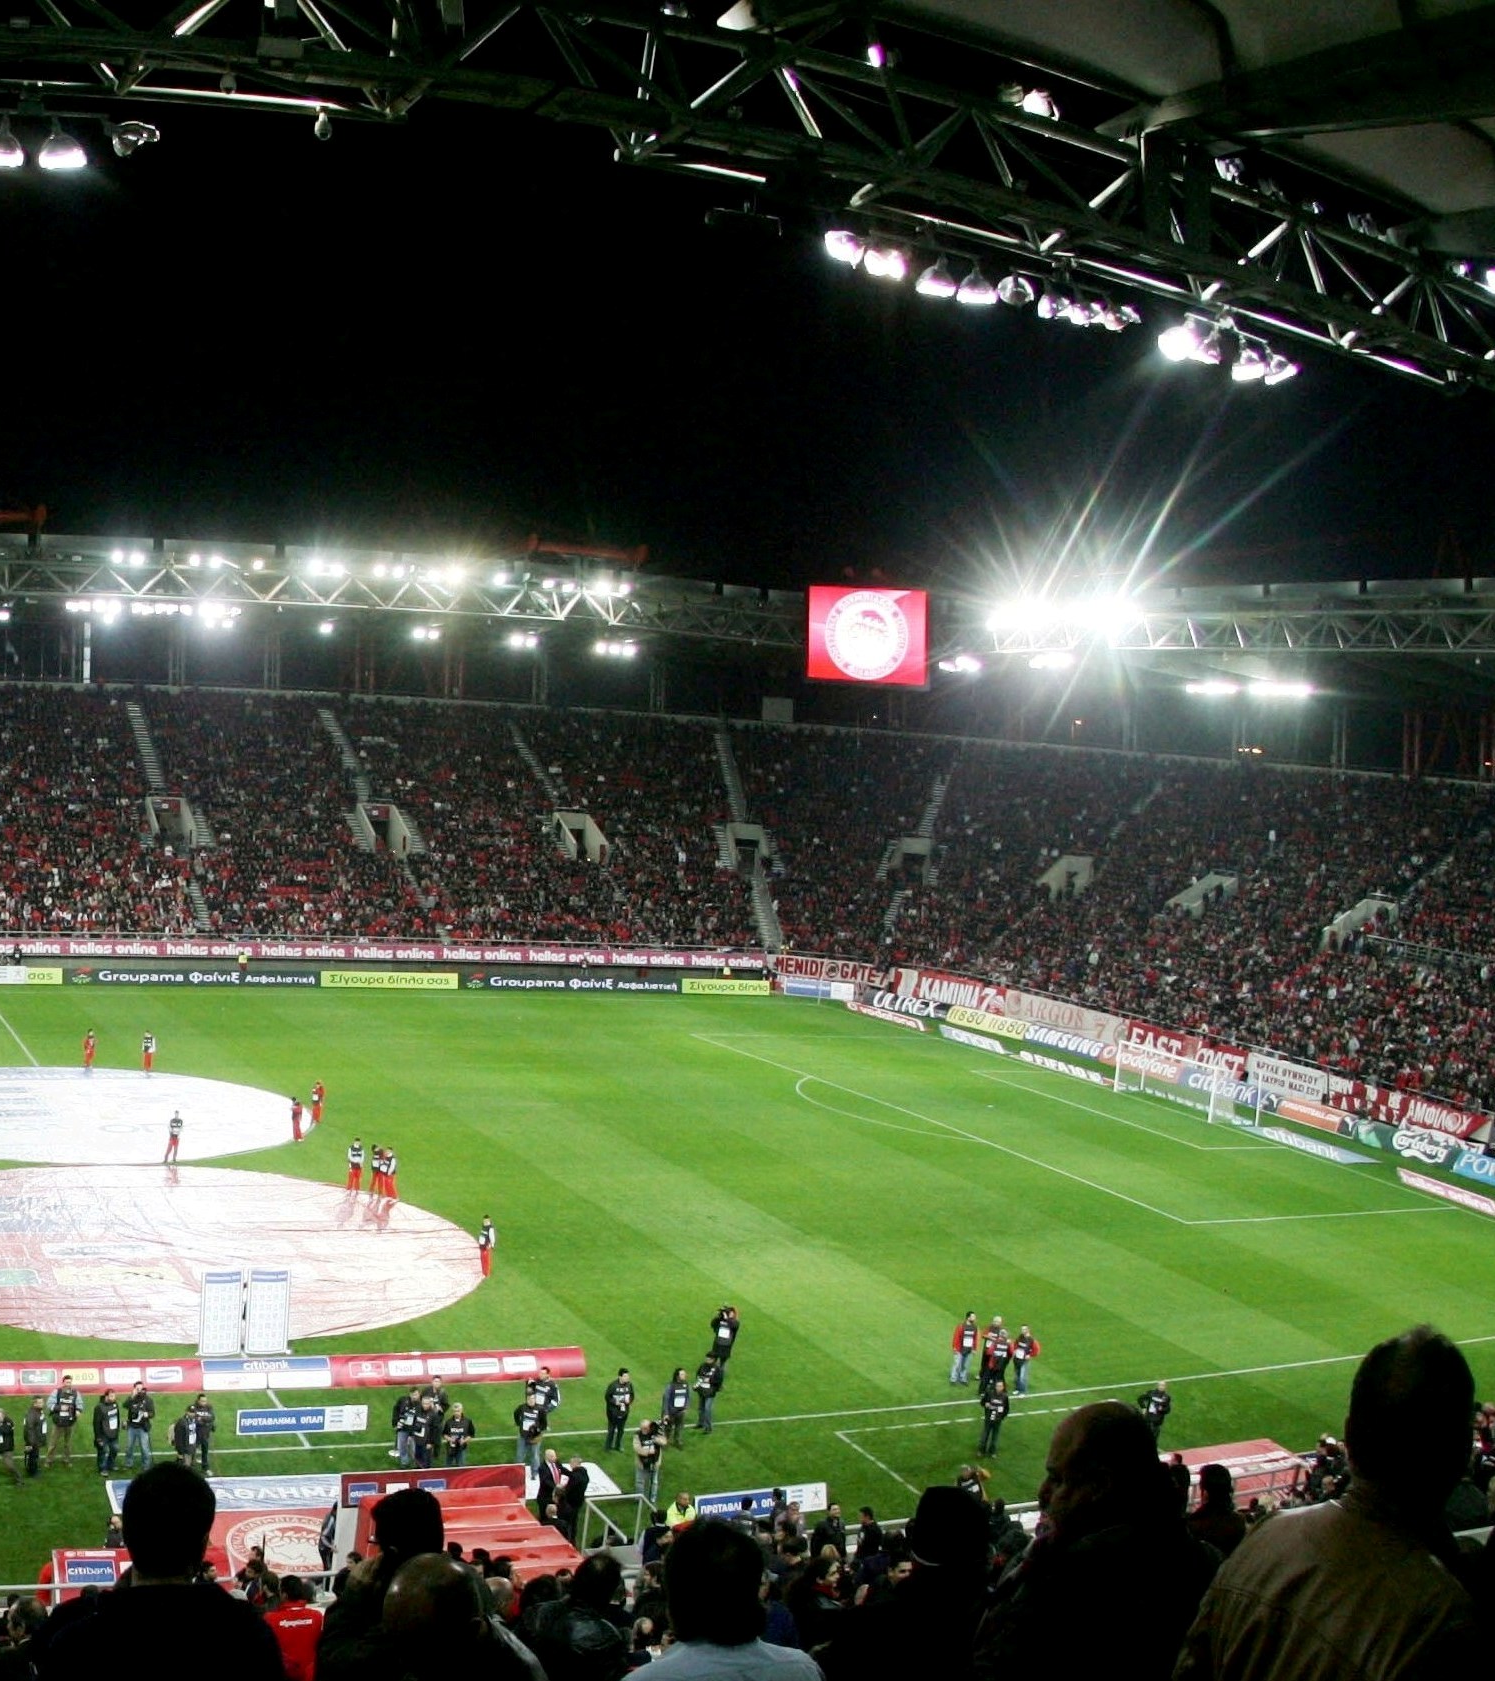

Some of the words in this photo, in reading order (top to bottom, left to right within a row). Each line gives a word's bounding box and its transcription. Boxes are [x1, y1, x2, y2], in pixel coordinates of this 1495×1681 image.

[70, 942, 112, 954] hellas
[116, 942, 157, 954] online
[167, 943, 208, 956] hellas
[212, 944, 252, 956] online
[262, 944, 301, 956] hellas
[306, 946, 345, 957] online
[354, 947, 393, 958] hellas
[396, 948, 434, 959] online
[443, 948, 481, 960] hellas
[485, 948, 521, 960] online
[530, 950, 565, 962] hellas
[613, 953, 647, 964] hellas
[650, 954, 684, 966] online
[692, 954, 725, 966] hellas
[728, 955, 763, 967] online
[776, 956, 824, 978] MENIDI
[840, 962, 877, 983] GATE
[98, 970, 183, 983] Groupama
[189, 972, 239, 984] Φοίνιξ
[329, 974, 383, 986] Σίγουρα
[490, 976, 565, 988] Groupama
[569, 978, 614, 990] Φοίνιξ
[919, 977, 981, 1010] KAMINIA
[873, 990, 941, 1018] ULTREX
[949, 1009, 986, 1025] 11880
[989, 1017, 1026, 1036] 11880
[1024, 1025, 1105, 1058] SAMSUNG
[1128, 1027, 1182, 1062] EAST
[1392, 1129, 1449, 1163] Carlsberg
[243, 1359, 289, 1371] citibank
[67, 1566, 114, 1575] citibank
